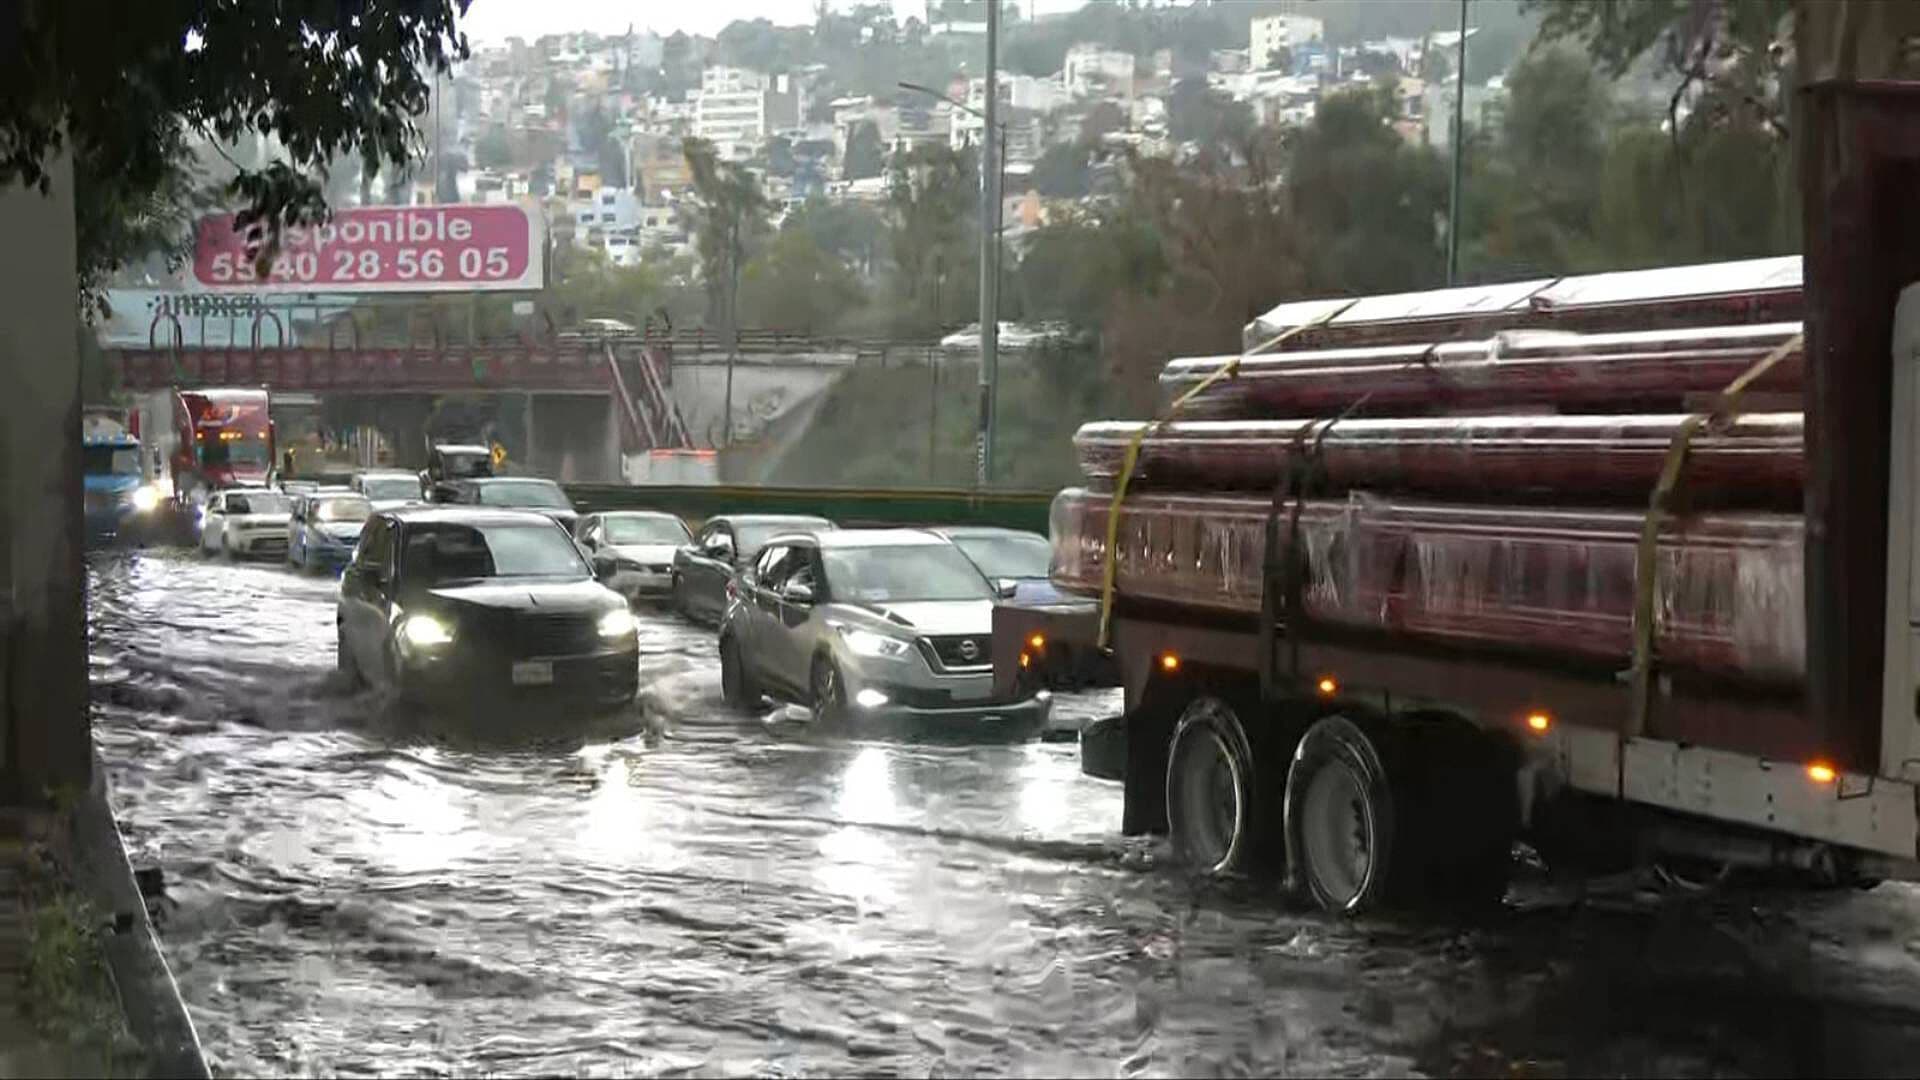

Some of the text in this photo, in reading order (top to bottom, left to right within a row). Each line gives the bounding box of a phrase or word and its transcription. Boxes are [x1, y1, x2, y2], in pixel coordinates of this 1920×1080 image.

[332, 249, 380, 281] 28
[397, 248, 445, 279] 56
[459, 247, 509, 279] 05
